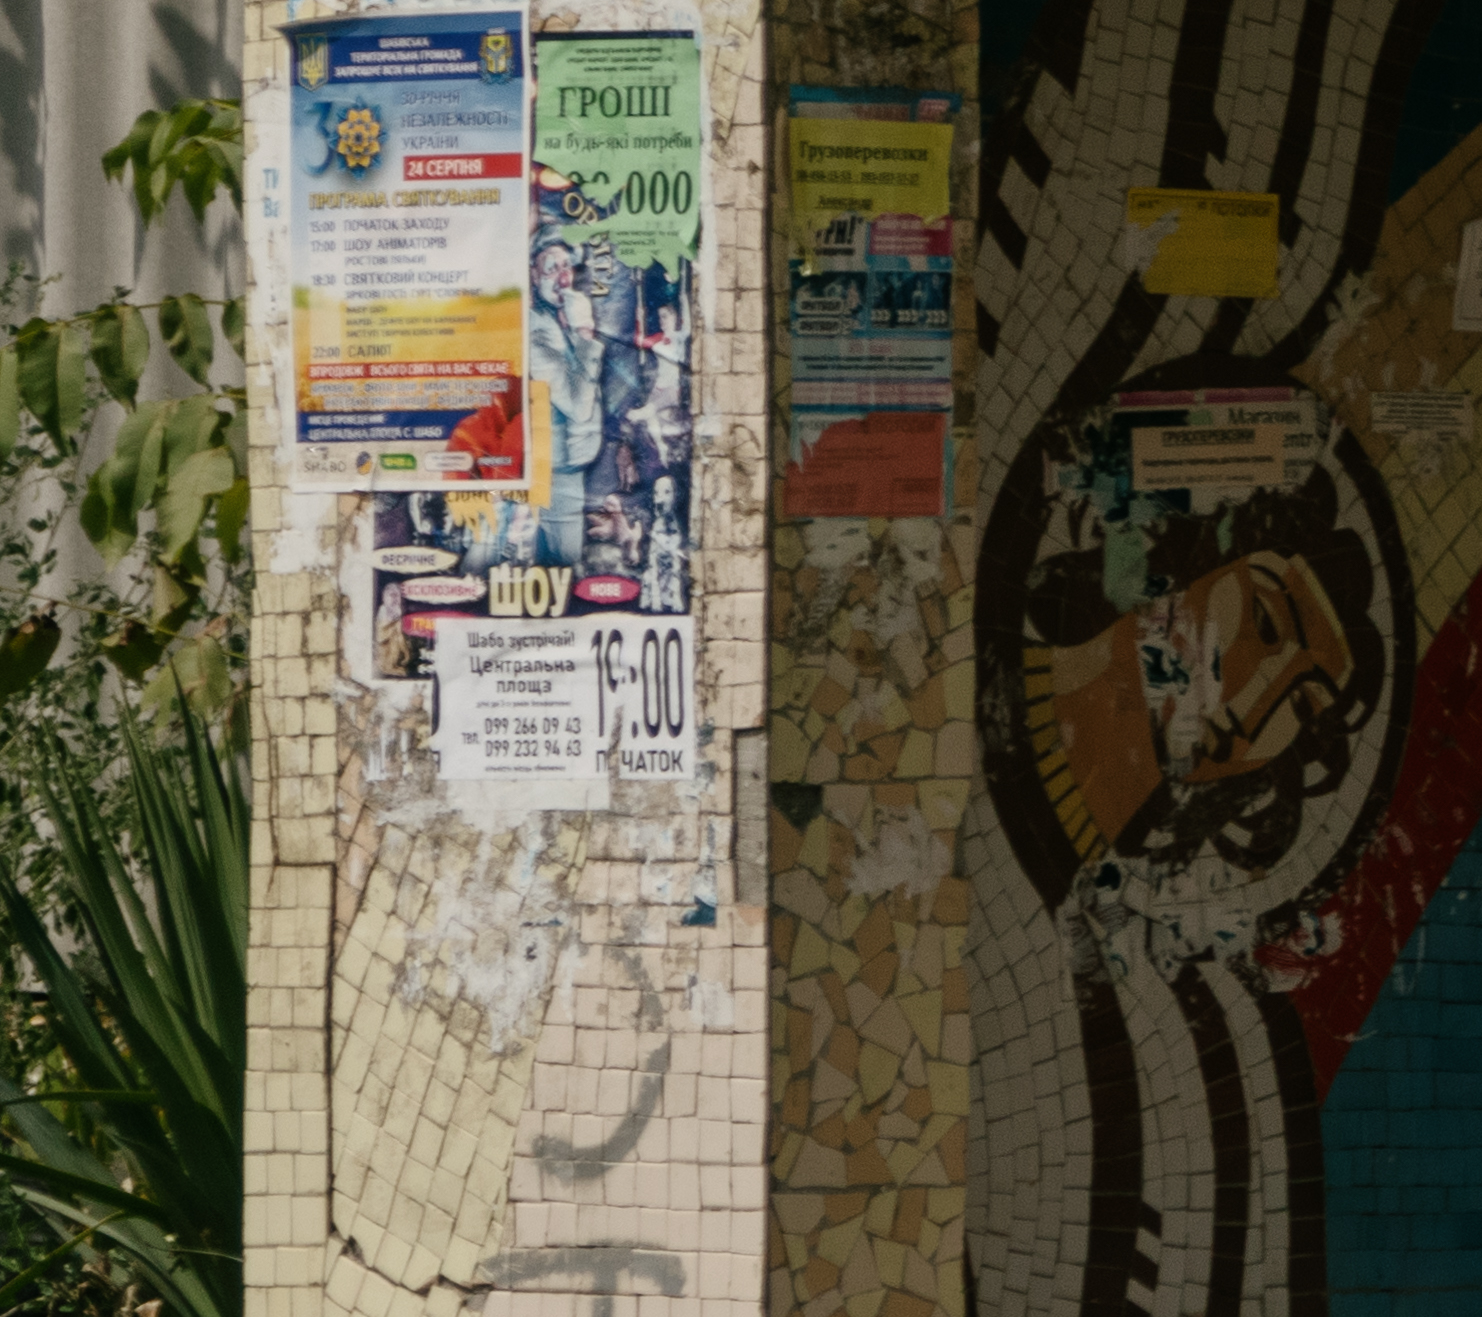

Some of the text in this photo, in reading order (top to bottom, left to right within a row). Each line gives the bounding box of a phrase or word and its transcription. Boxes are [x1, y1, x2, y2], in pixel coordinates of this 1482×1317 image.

[544, 135, 563, 150] на
[632, 131, 693, 151] потреби
[408, 158, 483, 176] 24 СЕРПНЯ
[489, 564, 572, 617] ШОУ
[467, 631, 504, 648] Шабо
[470, 657, 576, 675] Центральна
[485, 718, 509, 735] 099
[514, 717, 538, 734] 266
[543, 717, 559, 734] 09
[485, 740, 509, 757] 099
[514, 739, 538, 757] 232
[596, 749, 684, 774] ПЧАТОК
